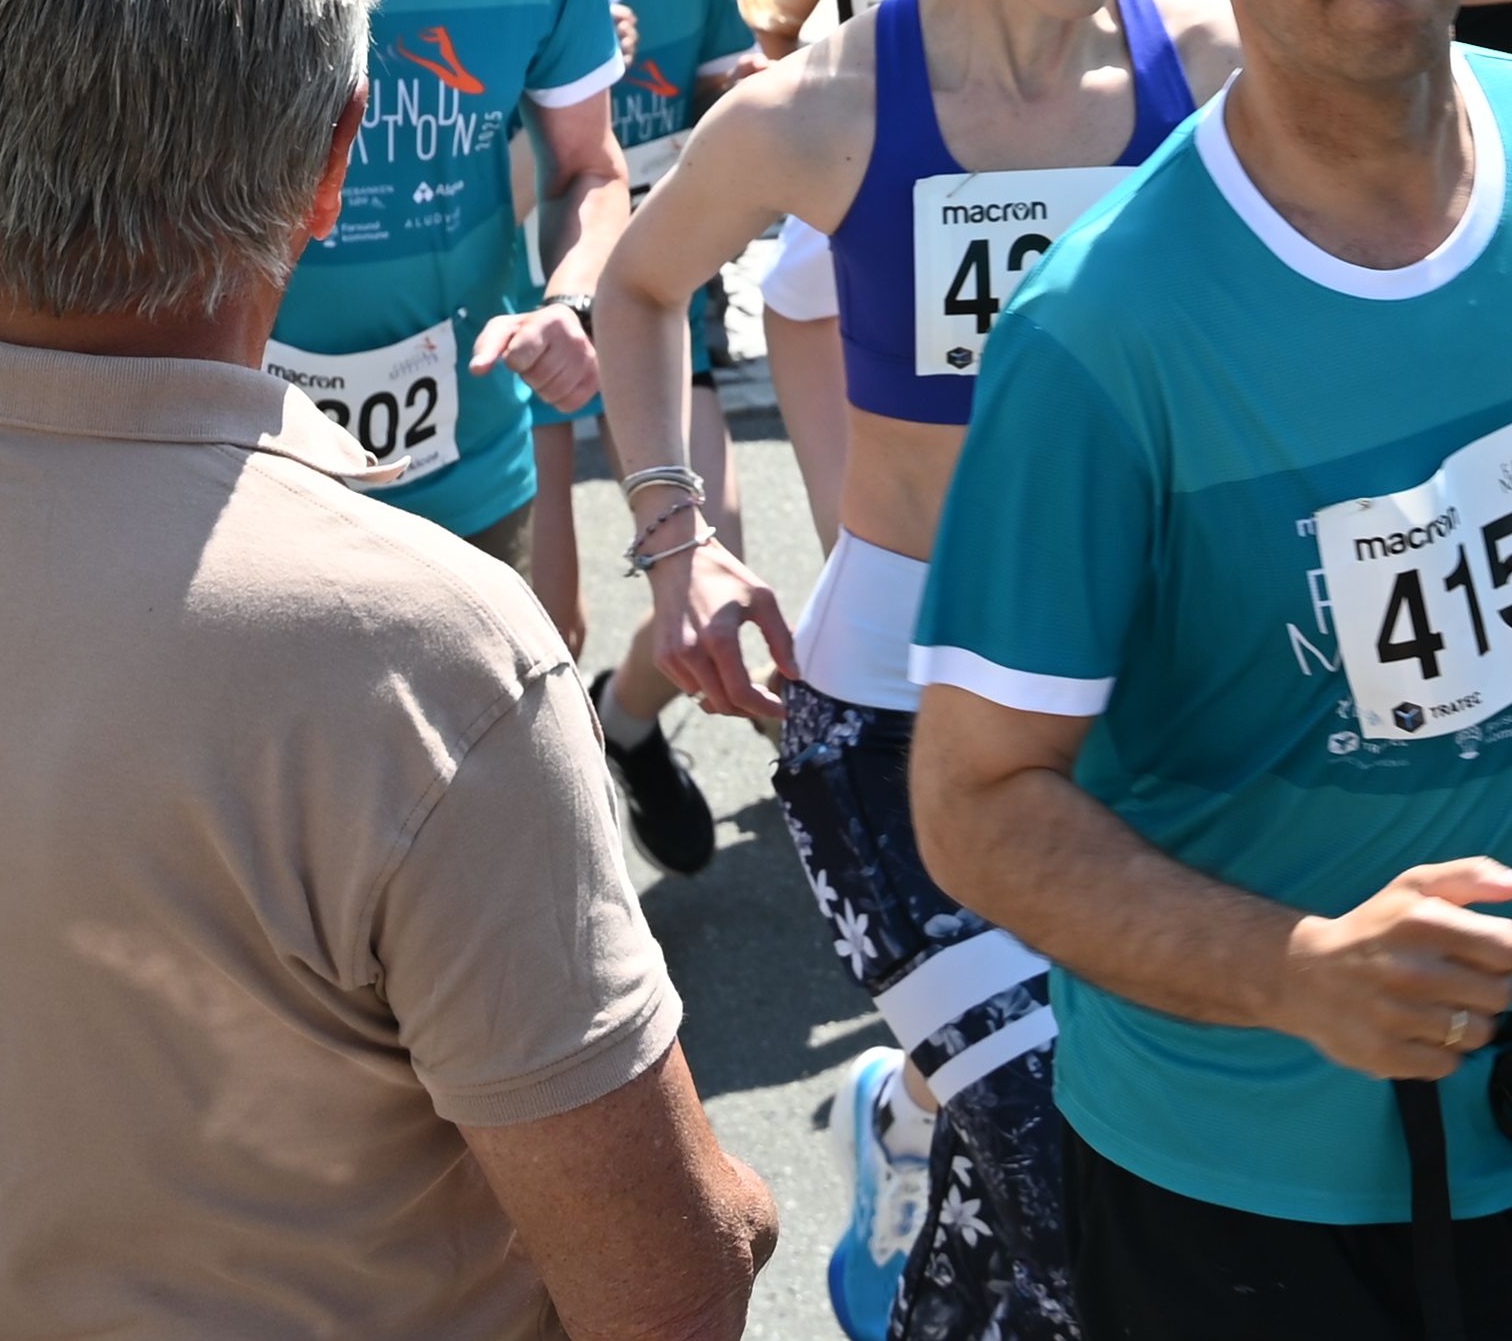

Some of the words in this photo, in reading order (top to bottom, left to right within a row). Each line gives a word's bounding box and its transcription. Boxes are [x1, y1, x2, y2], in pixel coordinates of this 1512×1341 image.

[942, 200, 1048, 225] macron
[267, 363, 346, 390] macron
[1353, 504, 1460, 561] macron
[1428, 690, 1484, 721] TRATEC
